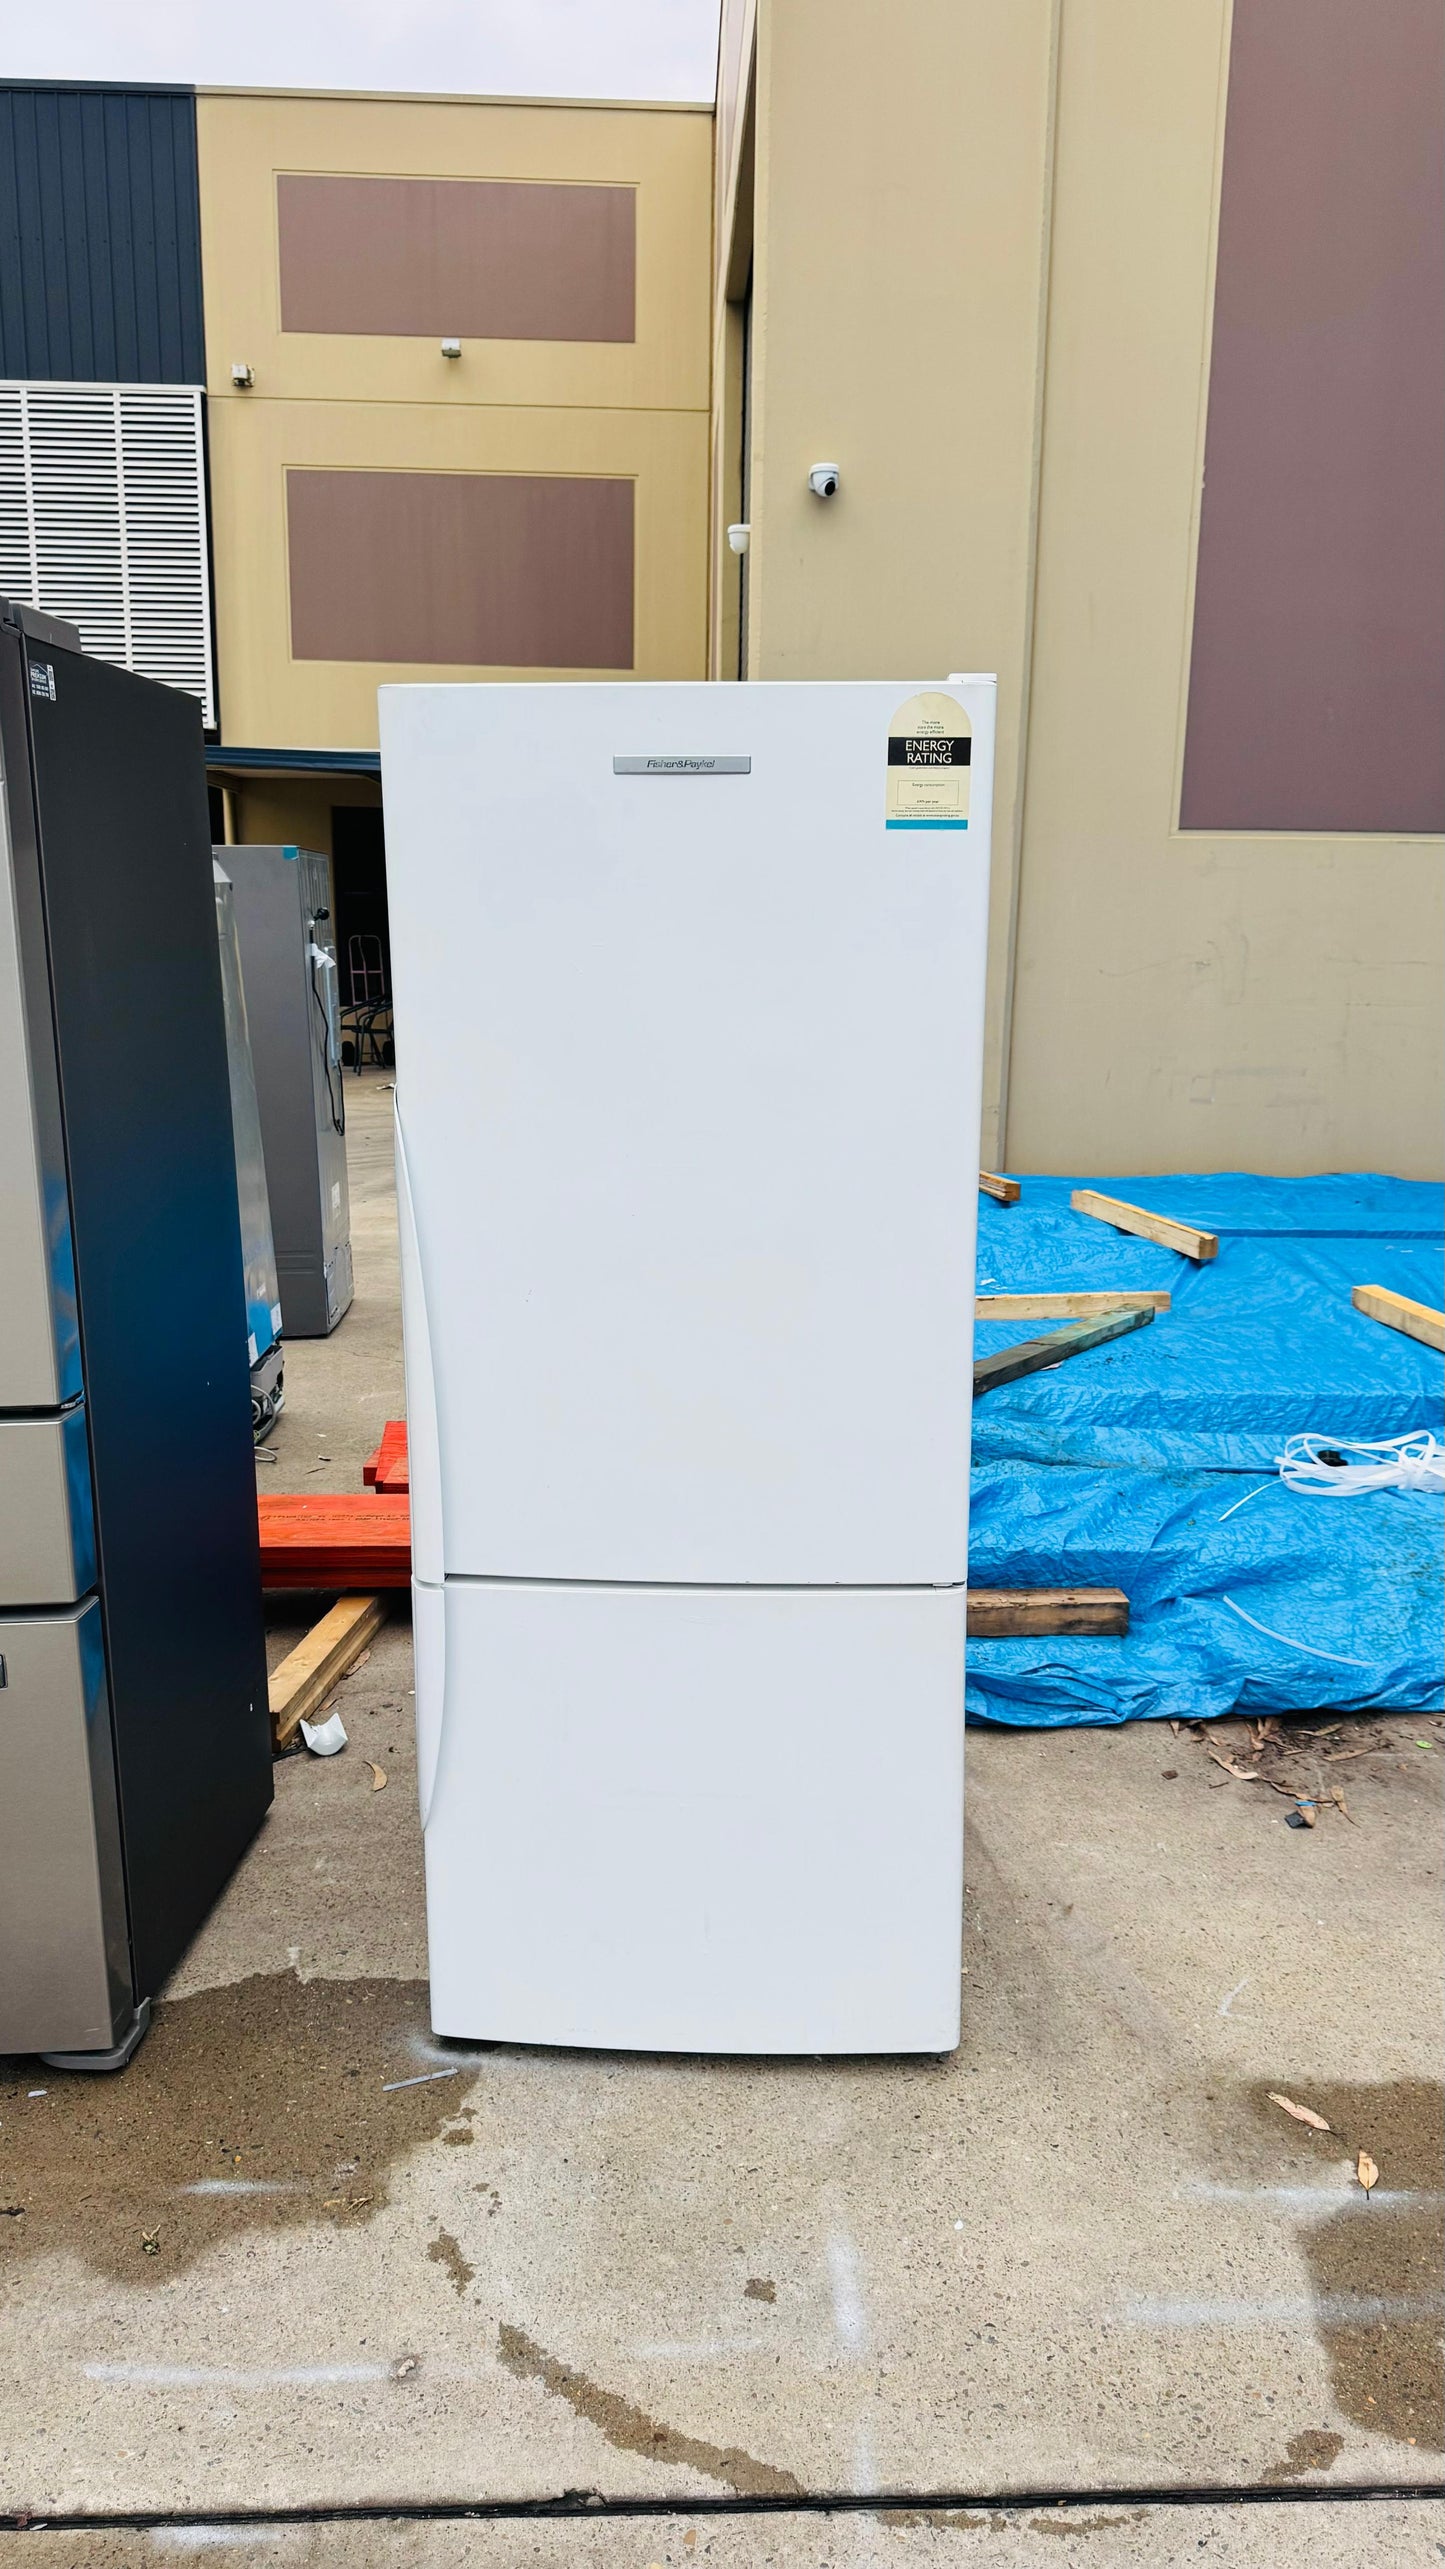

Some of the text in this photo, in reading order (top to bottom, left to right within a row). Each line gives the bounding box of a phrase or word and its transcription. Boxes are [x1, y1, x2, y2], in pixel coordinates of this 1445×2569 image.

[905, 740, 954, 751] ENERGY
[906, 752, 952, 764] RATING
[646, 759, 715, 770] Fisher&Paykel
